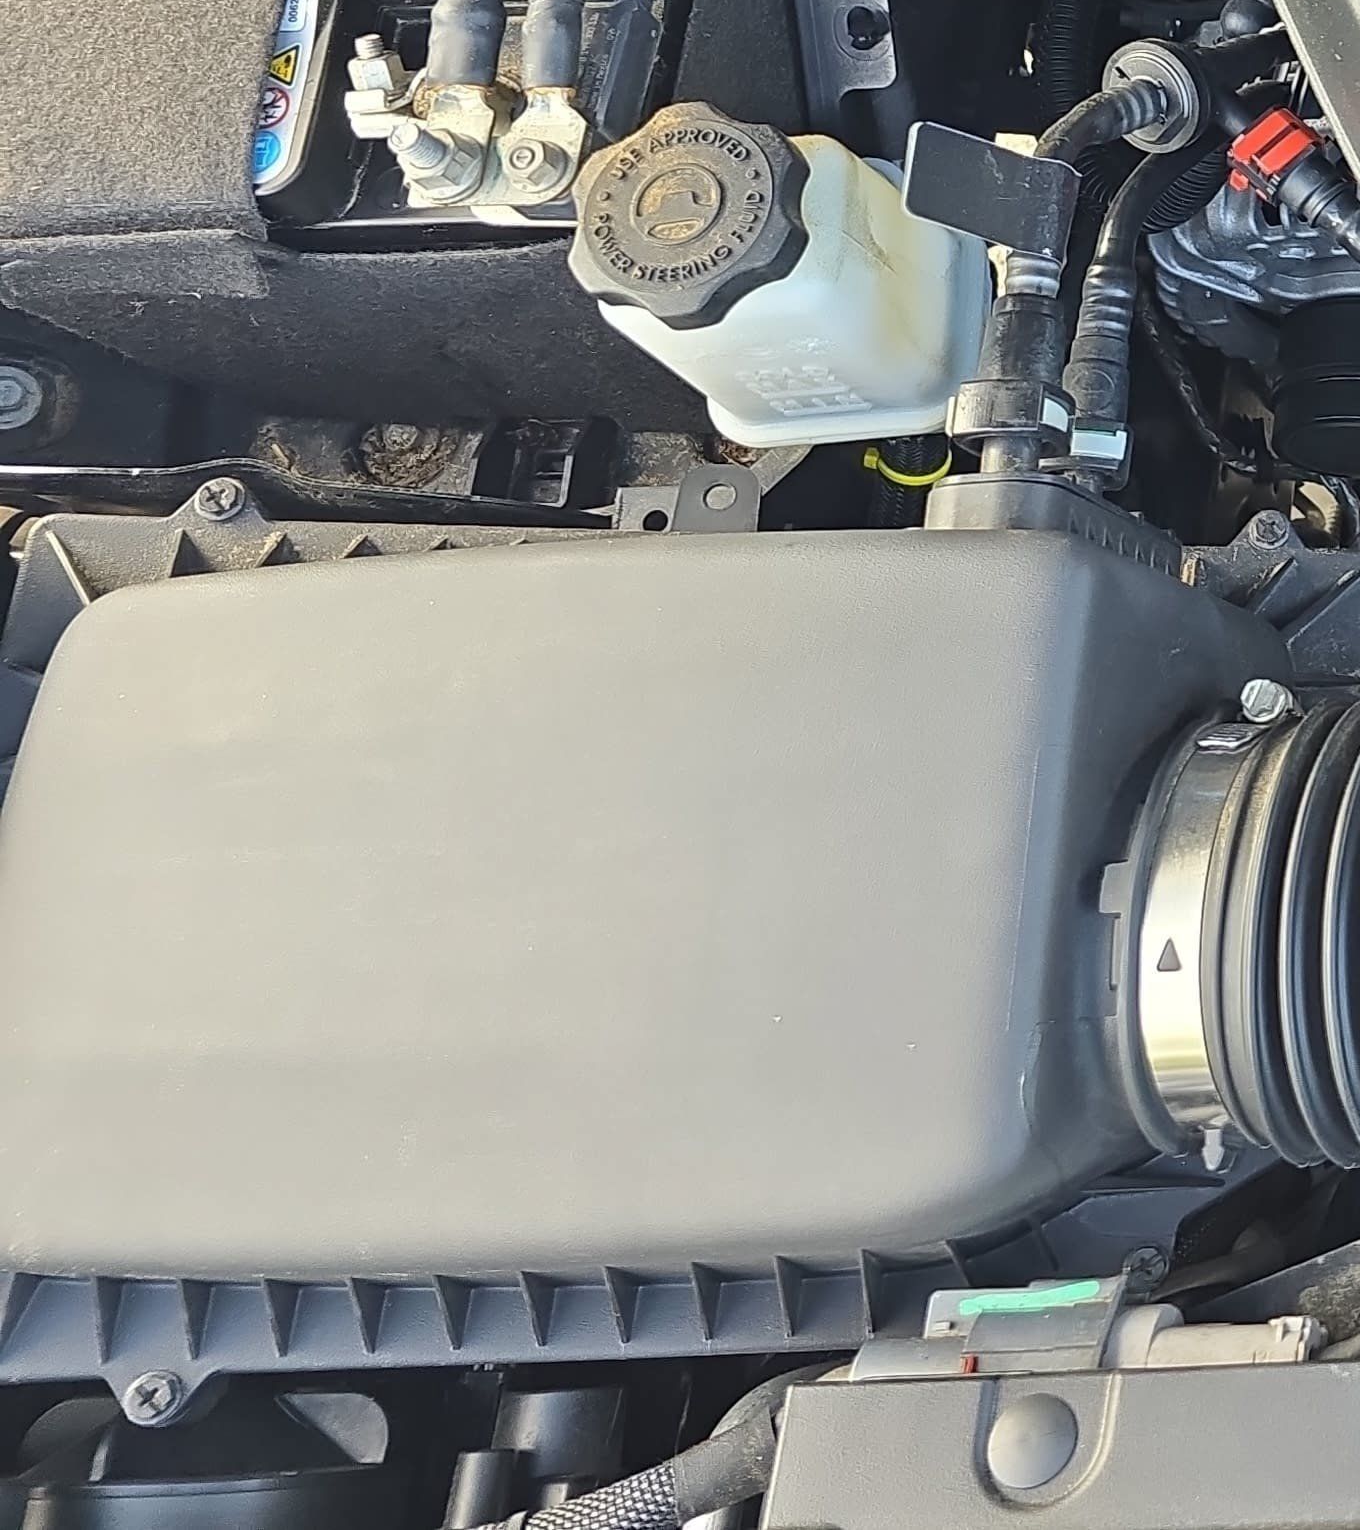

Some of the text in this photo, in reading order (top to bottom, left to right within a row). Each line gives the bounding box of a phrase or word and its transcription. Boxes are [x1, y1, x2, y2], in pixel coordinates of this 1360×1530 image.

[610, 128, 750, 180] USE APPROVED
[594, 190, 764, 282] POWER STEERING FLUID
